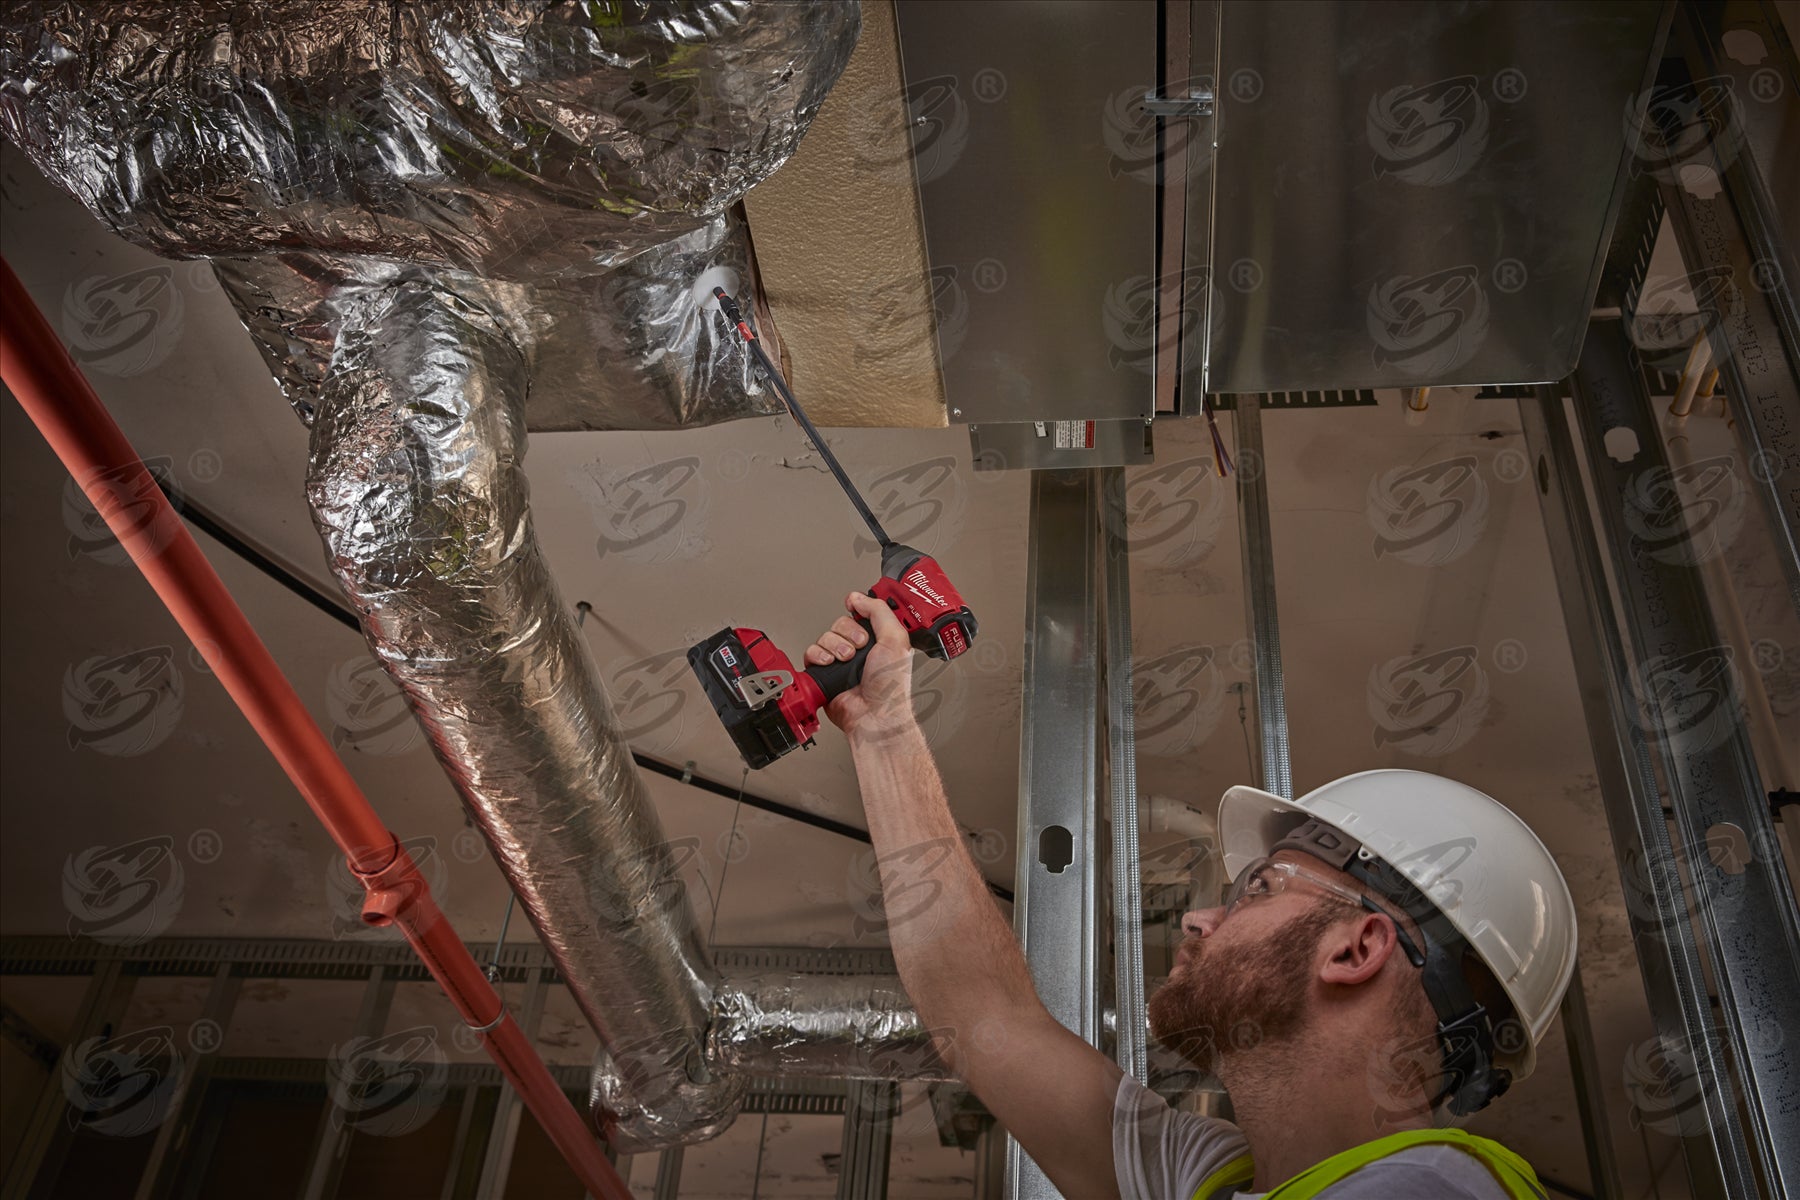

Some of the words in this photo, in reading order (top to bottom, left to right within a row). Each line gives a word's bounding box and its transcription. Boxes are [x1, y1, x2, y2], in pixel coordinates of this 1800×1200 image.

[907, 569, 948, 607] Milwaukee
[908, 605, 925, 623] FUEL
[950, 627, 965, 653] FUEL
[721, 647, 735, 665] M18
